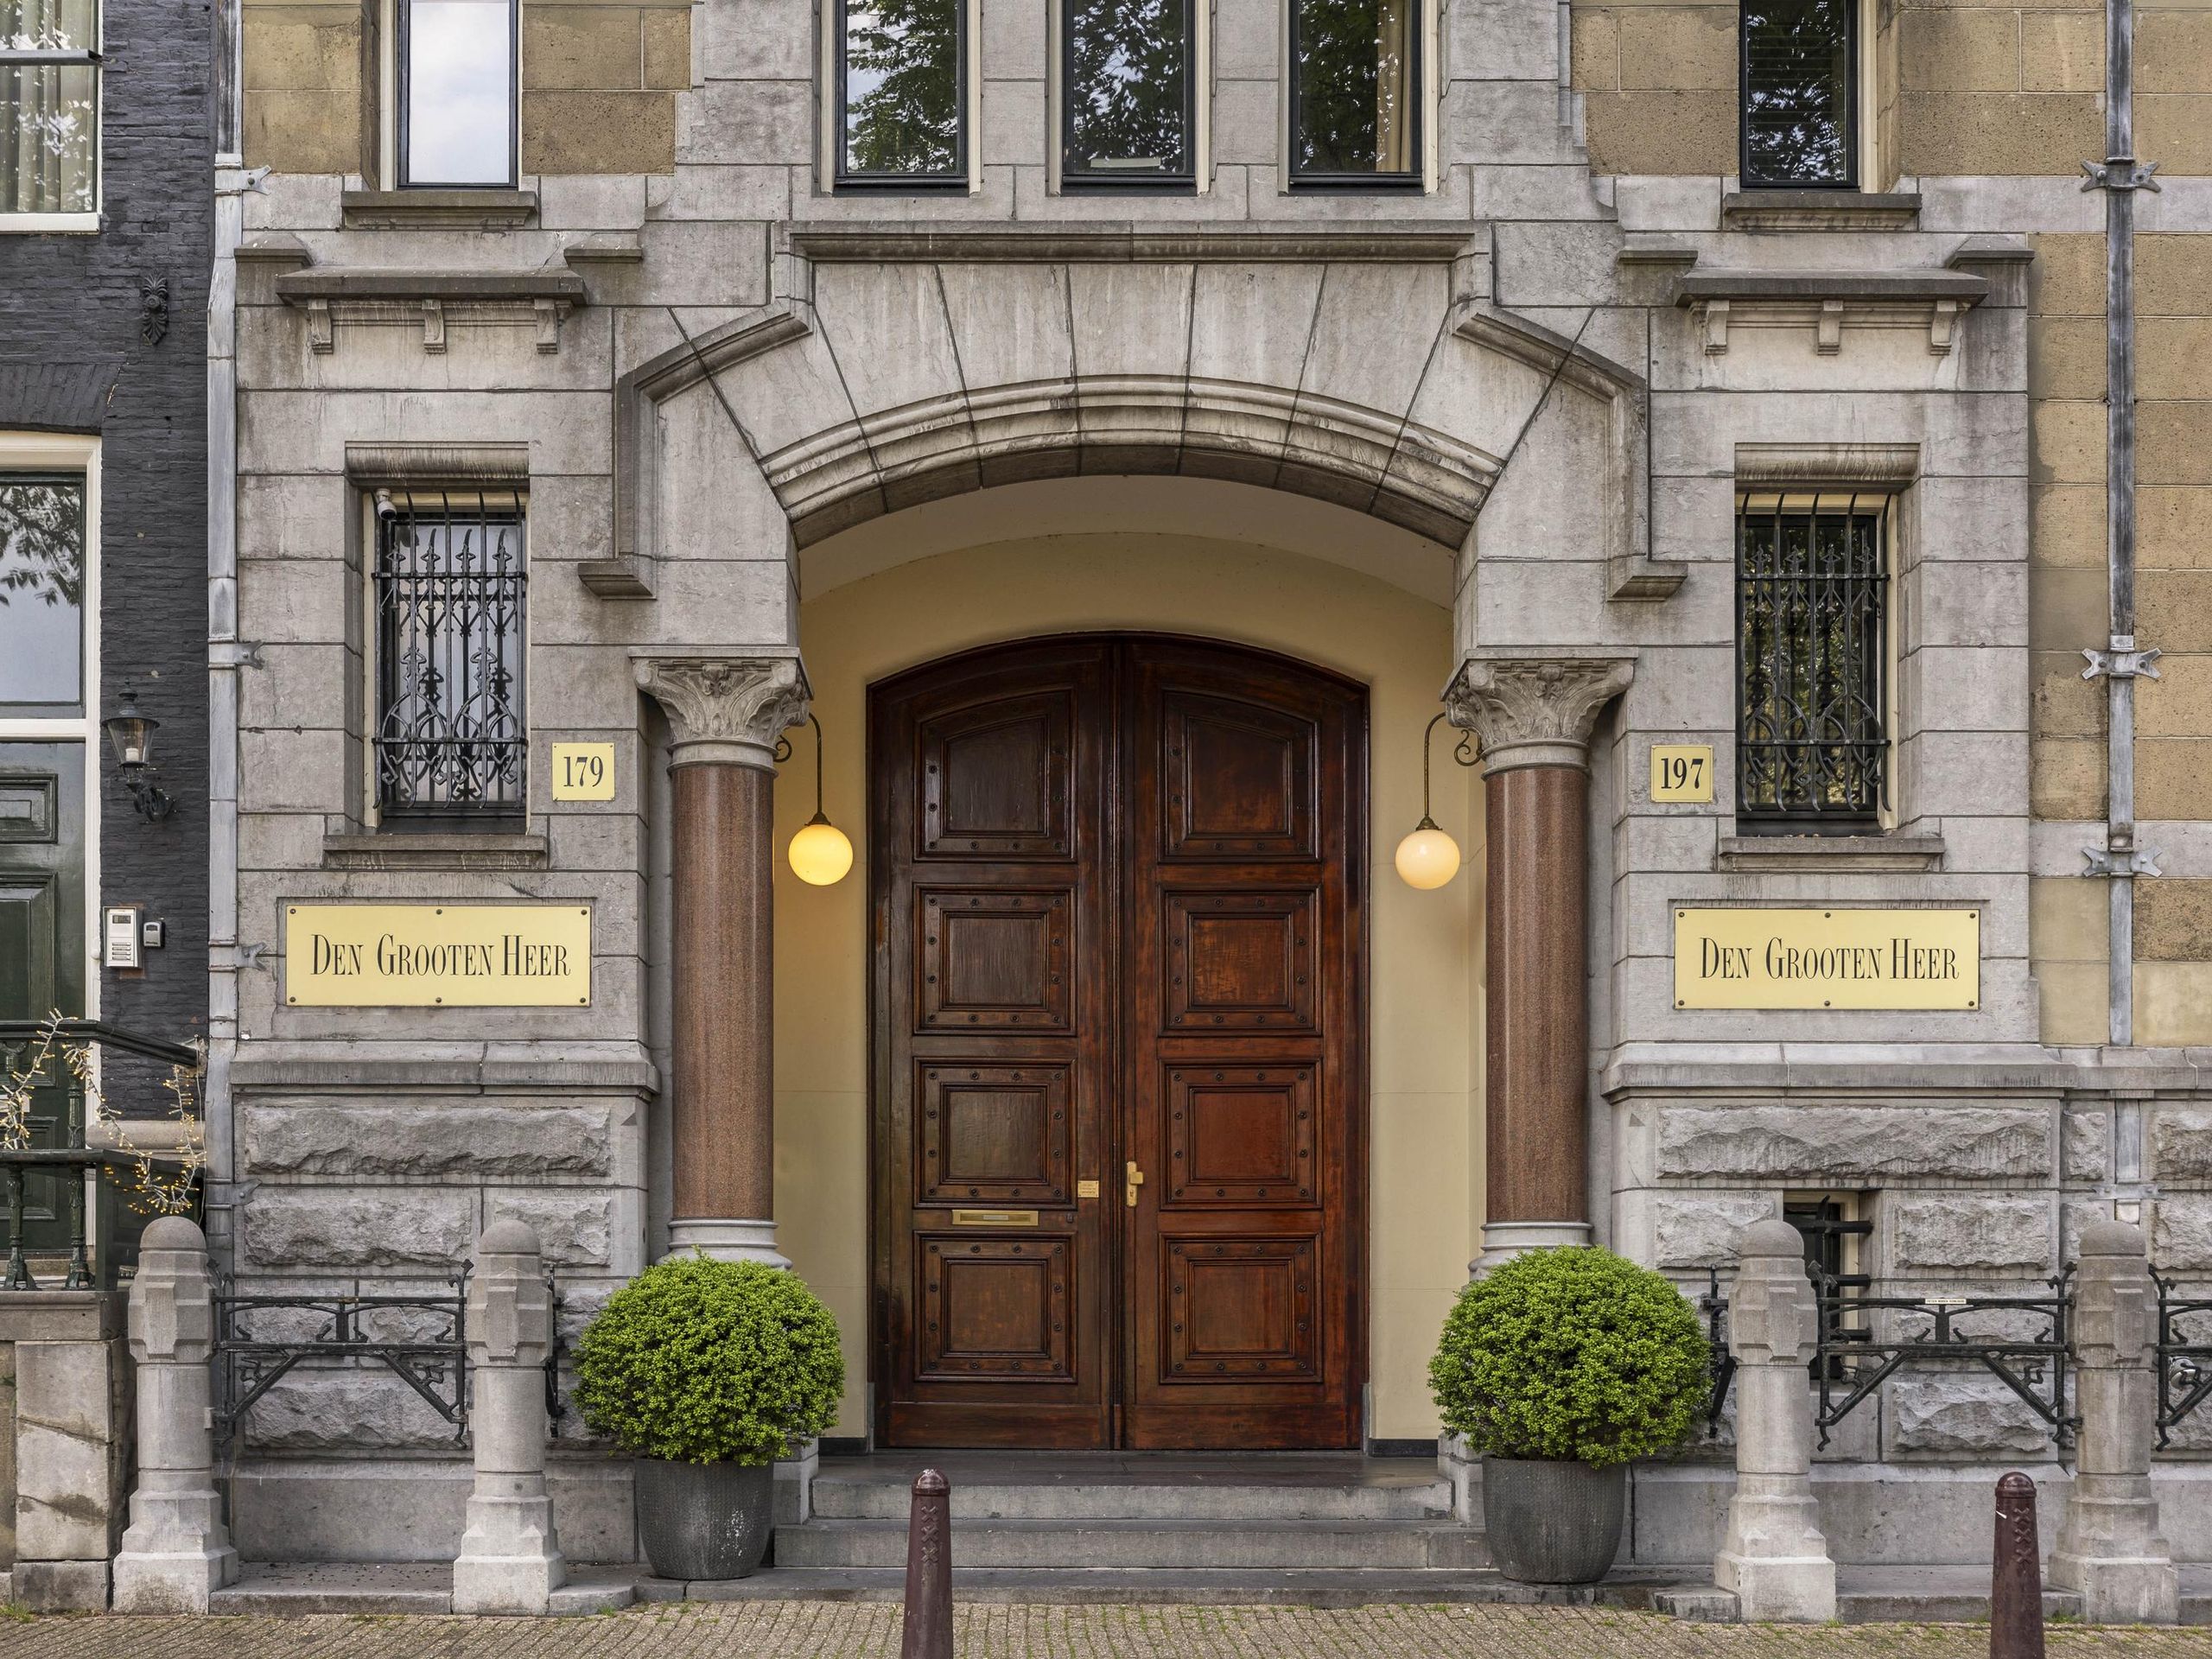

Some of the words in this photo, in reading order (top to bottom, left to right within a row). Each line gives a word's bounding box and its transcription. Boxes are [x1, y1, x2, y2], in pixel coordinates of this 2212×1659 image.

[563, 755, 604, 787] 179
[1660, 757, 1705, 790] 197
[310, 933, 365, 976] DEN
[377, 933, 495, 976] GROOTEN
[500, 933, 572, 976] HEER
[1699, 937, 1753, 980] DEN
[1765, 937, 1884, 980] GROOTEN
[1889, 937, 1961, 980] HEER
